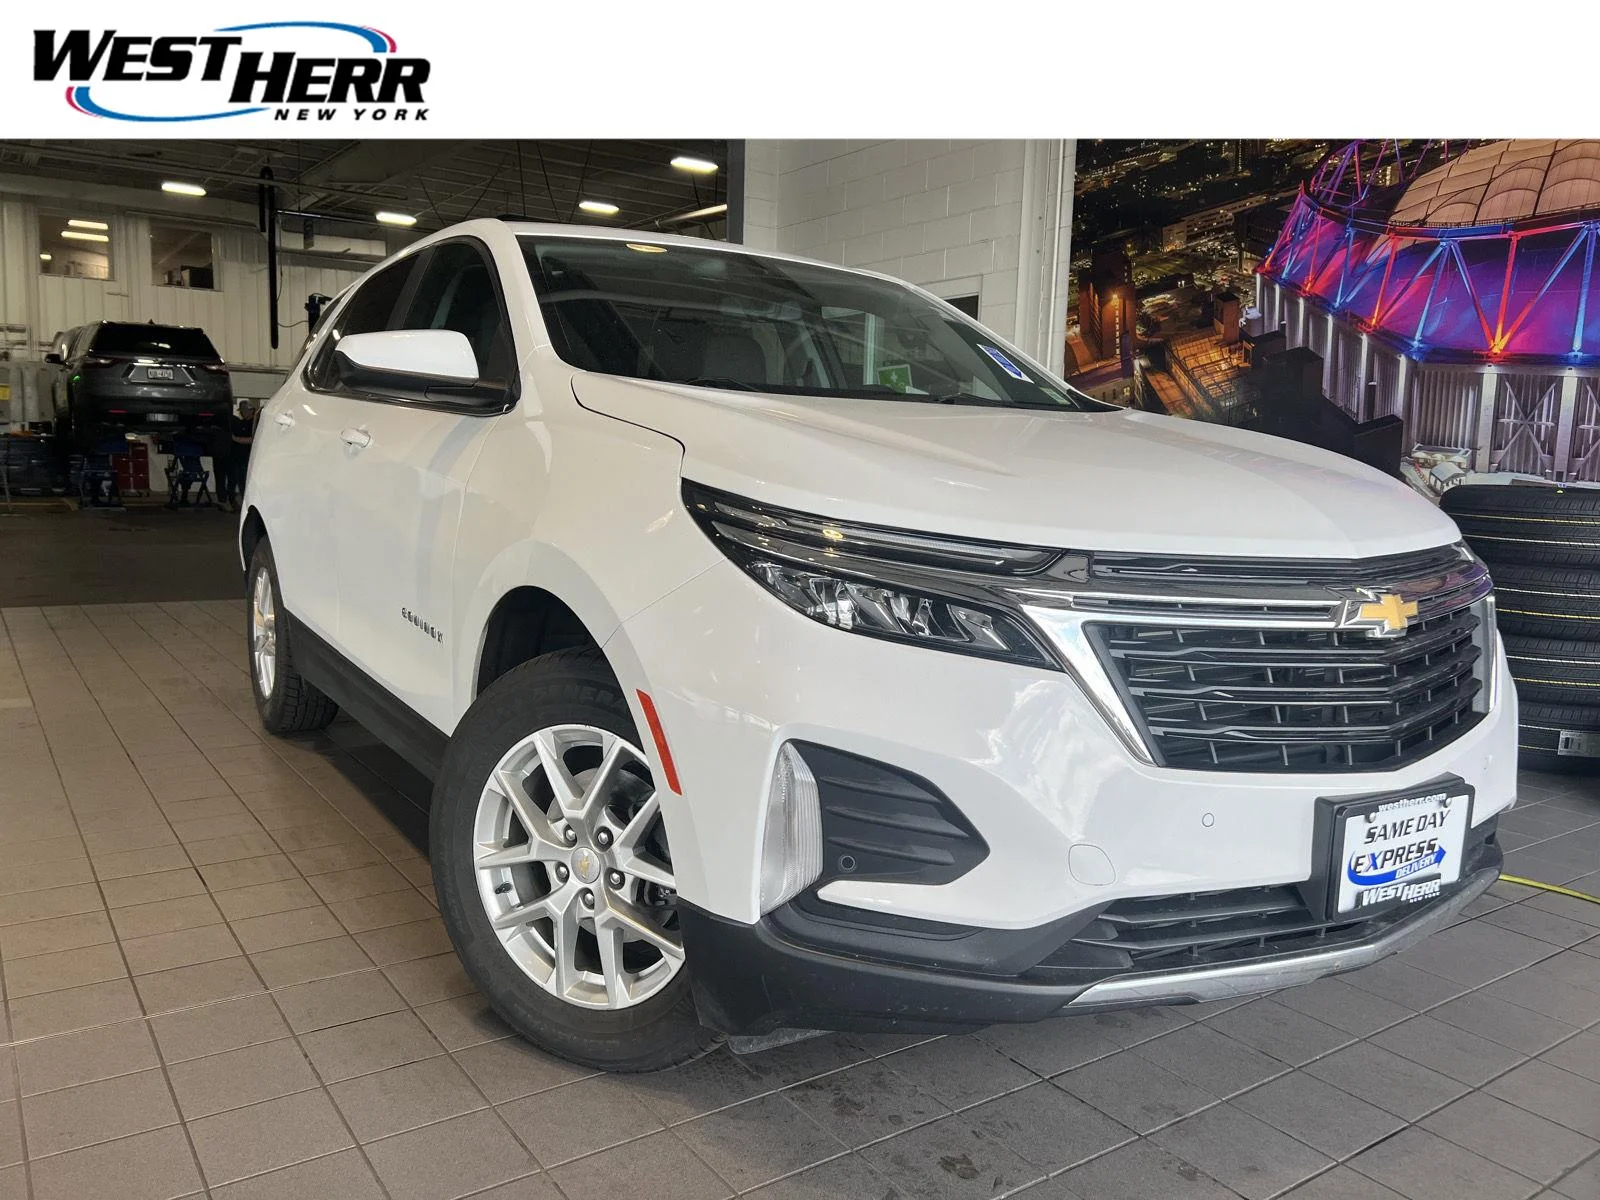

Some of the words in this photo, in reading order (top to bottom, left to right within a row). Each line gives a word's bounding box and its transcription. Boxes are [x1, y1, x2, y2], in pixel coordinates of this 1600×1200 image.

[1379, 793, 1447, 812] westherr.com
[1364, 817, 1414, 844] SAME
[1415, 809, 1451, 833] DAY
[1354, 837, 1438, 874] EXPRESS
[1395, 853, 1437, 879] DELIVERY
